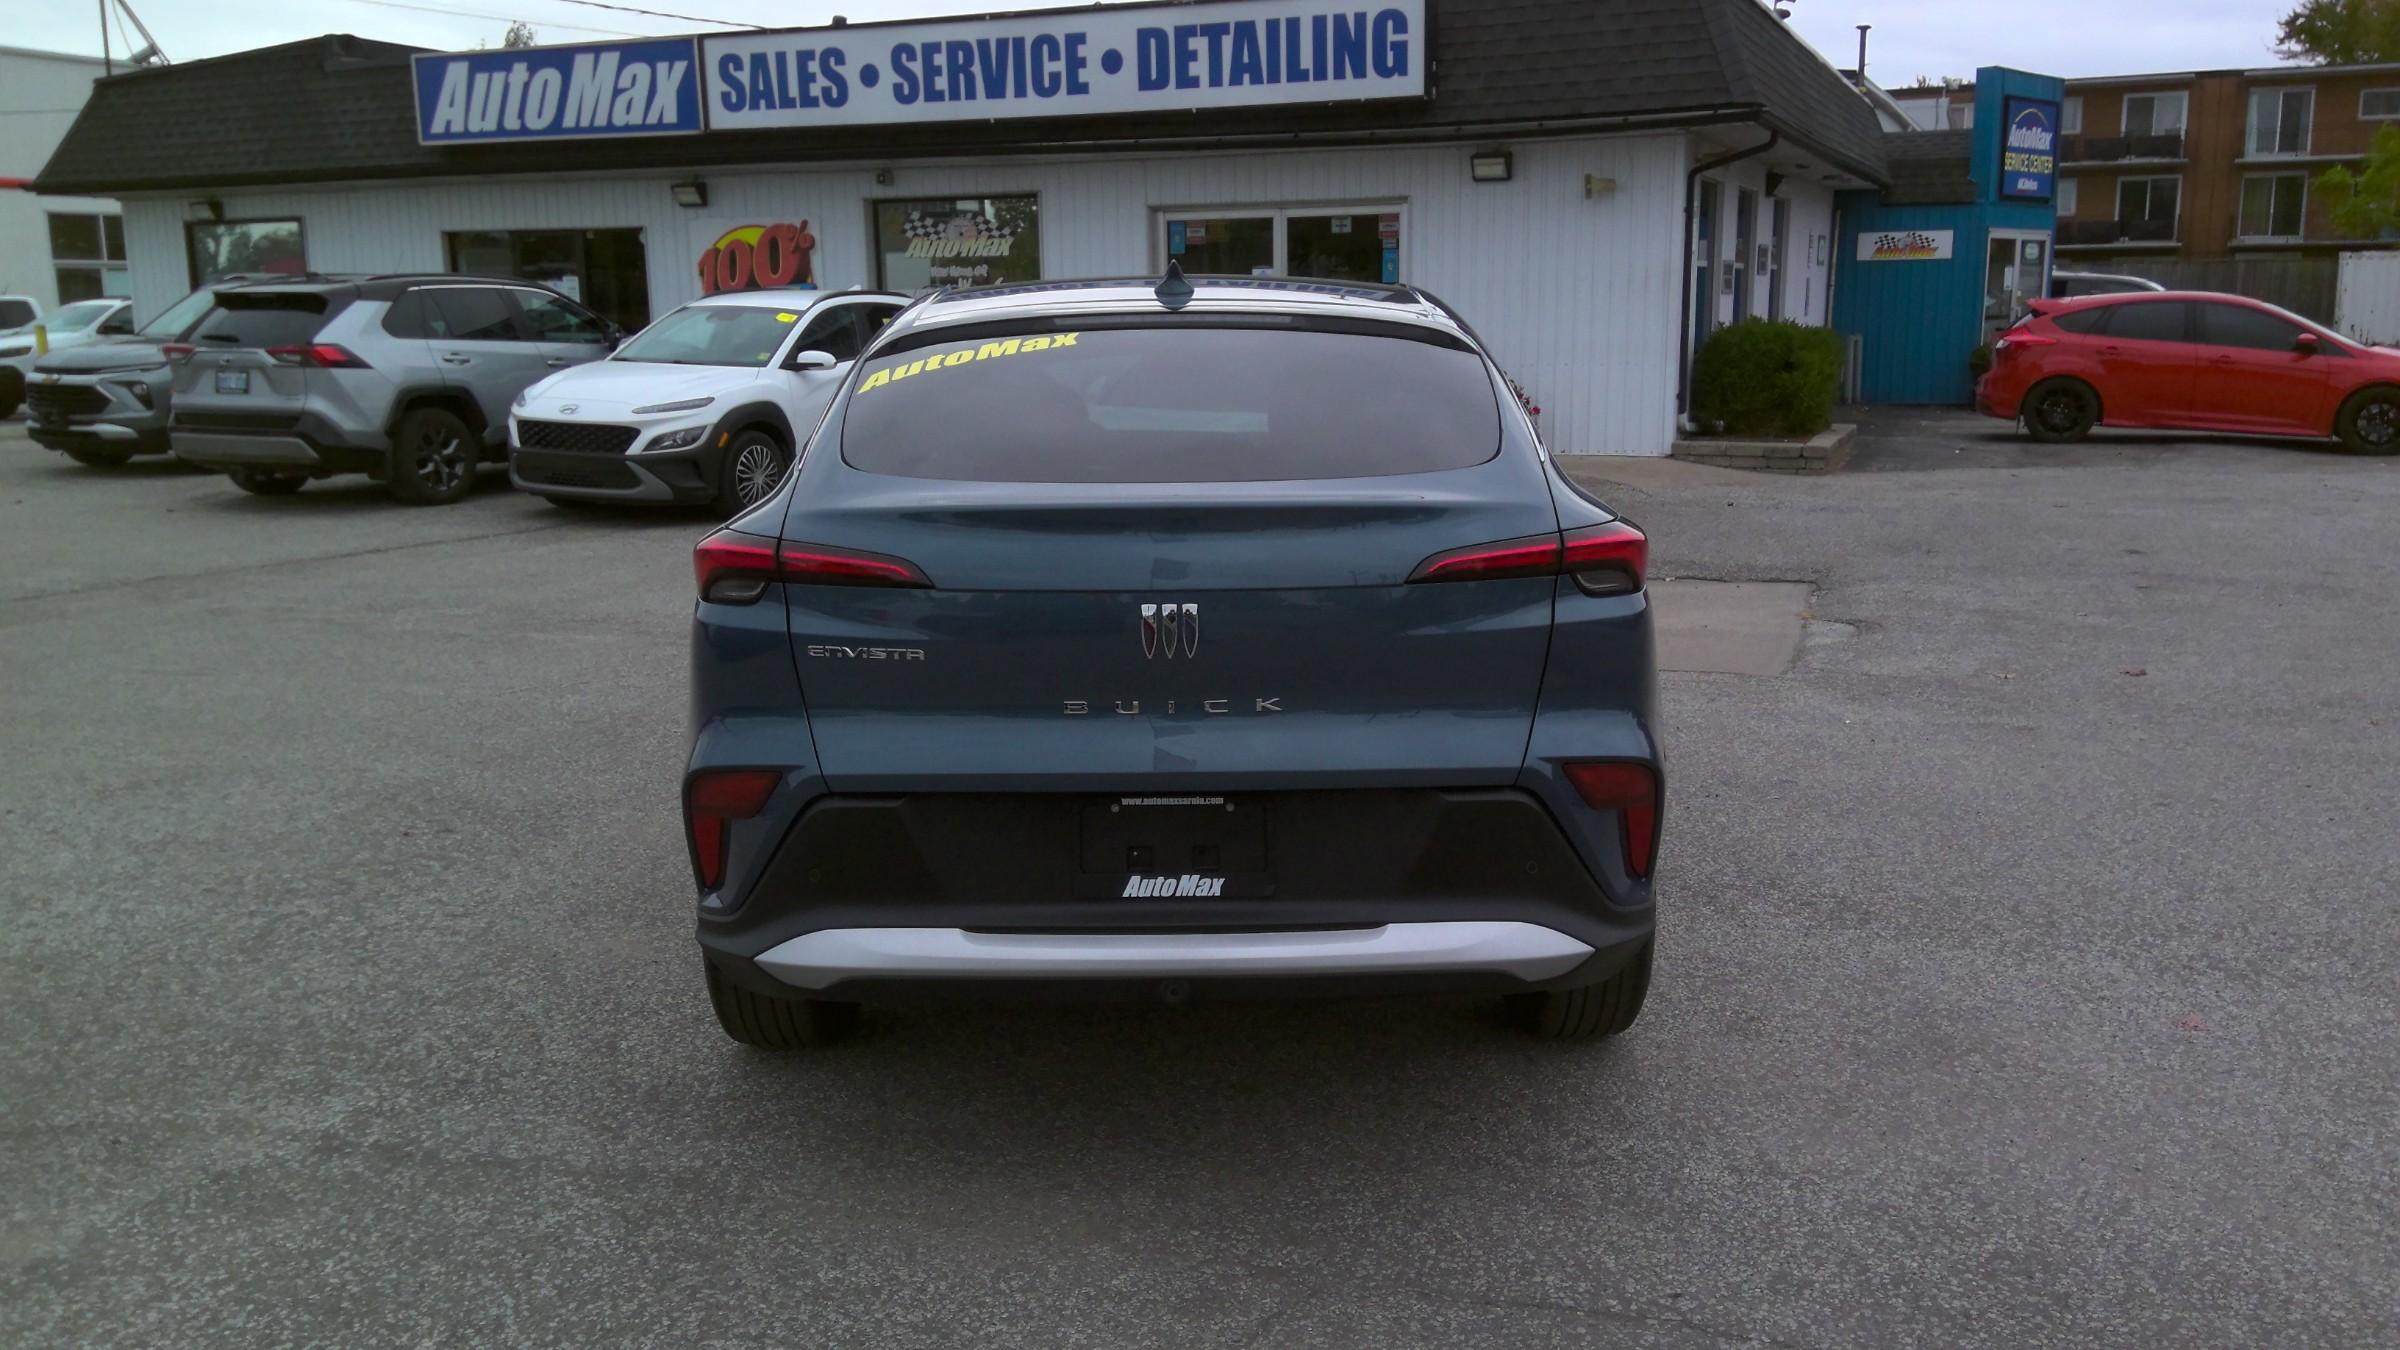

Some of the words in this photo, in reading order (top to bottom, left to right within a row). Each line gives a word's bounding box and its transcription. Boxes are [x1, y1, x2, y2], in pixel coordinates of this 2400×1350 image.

[718, 47, 849, 113] SALES
[890, 32, 1090, 104] SERVICE
[1137, 8, 1409, 92] DETAILING
[698, 219, 816, 294] 100%
[858, 332, 1080, 394] AutoMax
[807, 645, 925, 660] ENVISTA
[1064, 698, 1283, 714] BUICK
